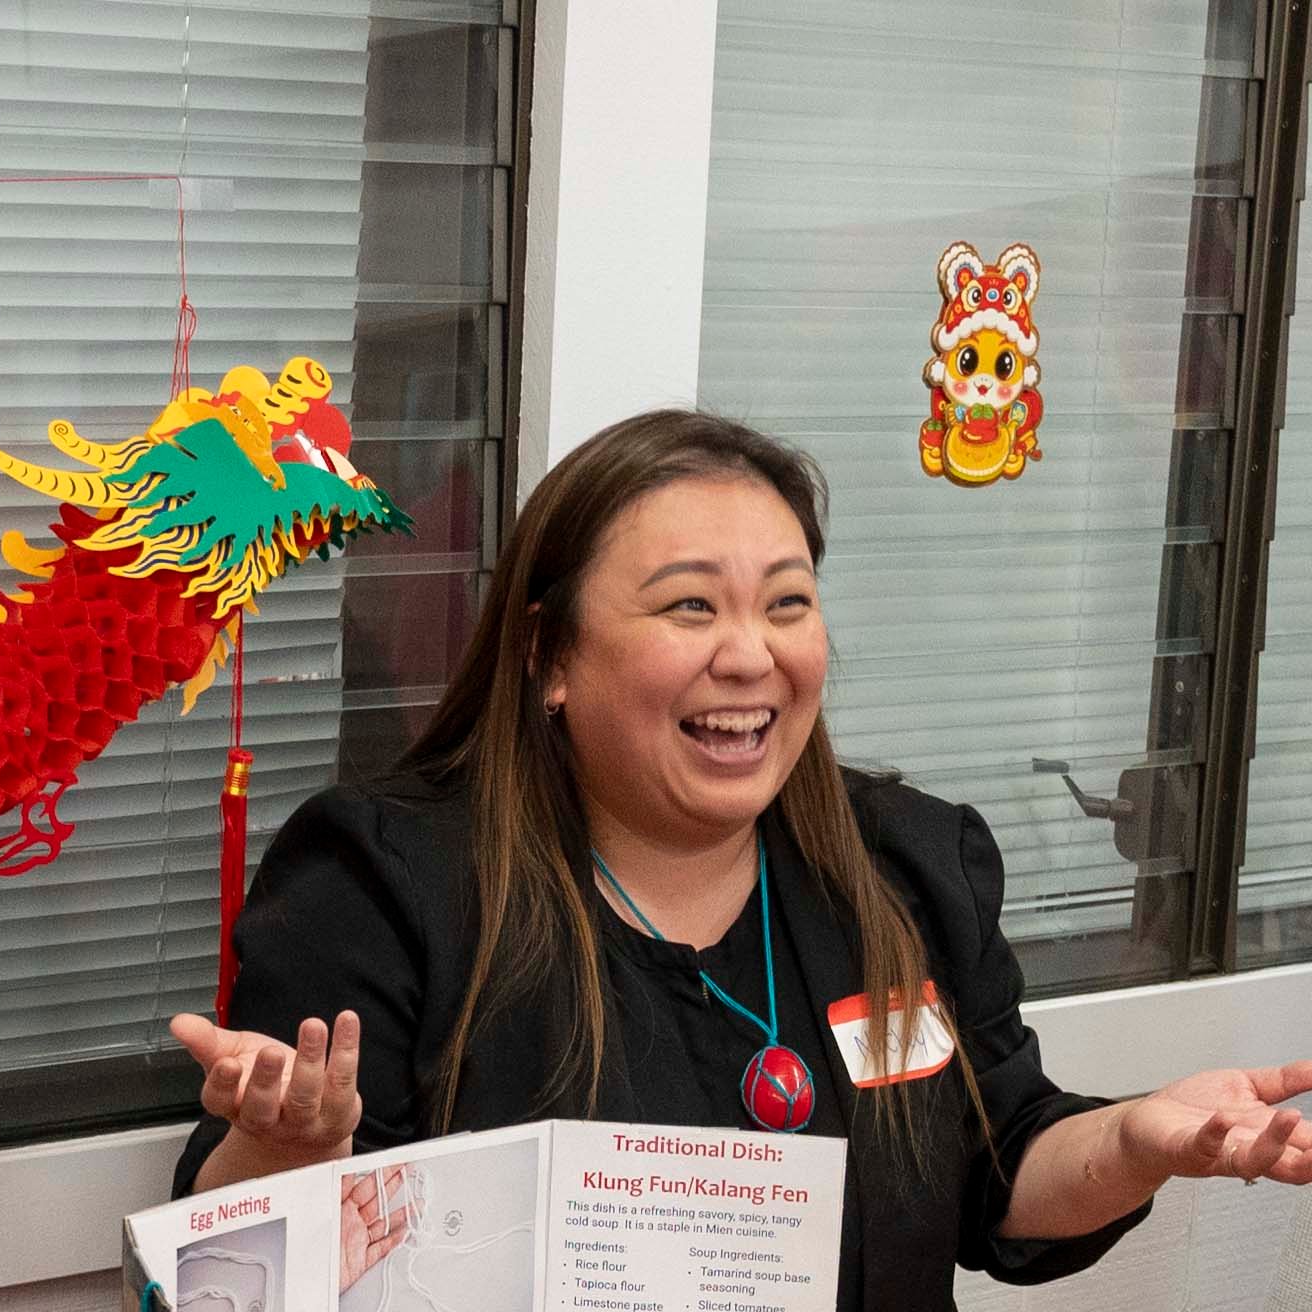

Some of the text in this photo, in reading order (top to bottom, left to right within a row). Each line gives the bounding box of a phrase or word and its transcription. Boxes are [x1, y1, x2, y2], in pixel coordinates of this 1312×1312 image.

[613, 1134, 782, 1162] Traditional Dish:
[584, 1172, 808, 1205] Klung Fun/Kalang Fen
[190, 1196, 270, 1231] Egg Netting
[567, 1200, 589, 1212] This
[592, 1202, 615, 1214] dish
[618, 1204, 628, 1214] is
[640, 1206, 695, 1220] refreshing
[698, 1210, 736, 1222] savory,
[739, 1212, 768, 1225] spicy,
[772, 1214, 802, 1227] tangy
[566, 1216, 588, 1226] cold
[625, 1220, 632, 1229] It
[636, 1220, 644, 1230] is
[658, 1222, 690, 1233] staple
[693, 1223, 702, 1232] in
[706, 1224, 733, 1234] Mien
[736, 1227, 776, 1238] cuisine.
[565, 1240, 627, 1253] Ingredients:
[689, 1248, 784, 1263] Soup Ingredients:
[576, 1260, 626, 1271] Rice flour
[700, 1267, 810, 1283] Tamarind soup base
[575, 1278, 645, 1292] Tapioca flour
[700, 1283, 756, 1296] seasoning
[574, 1296, 663, 1312] Limestone paste
[698, 1300, 731, 1311] Sliced
